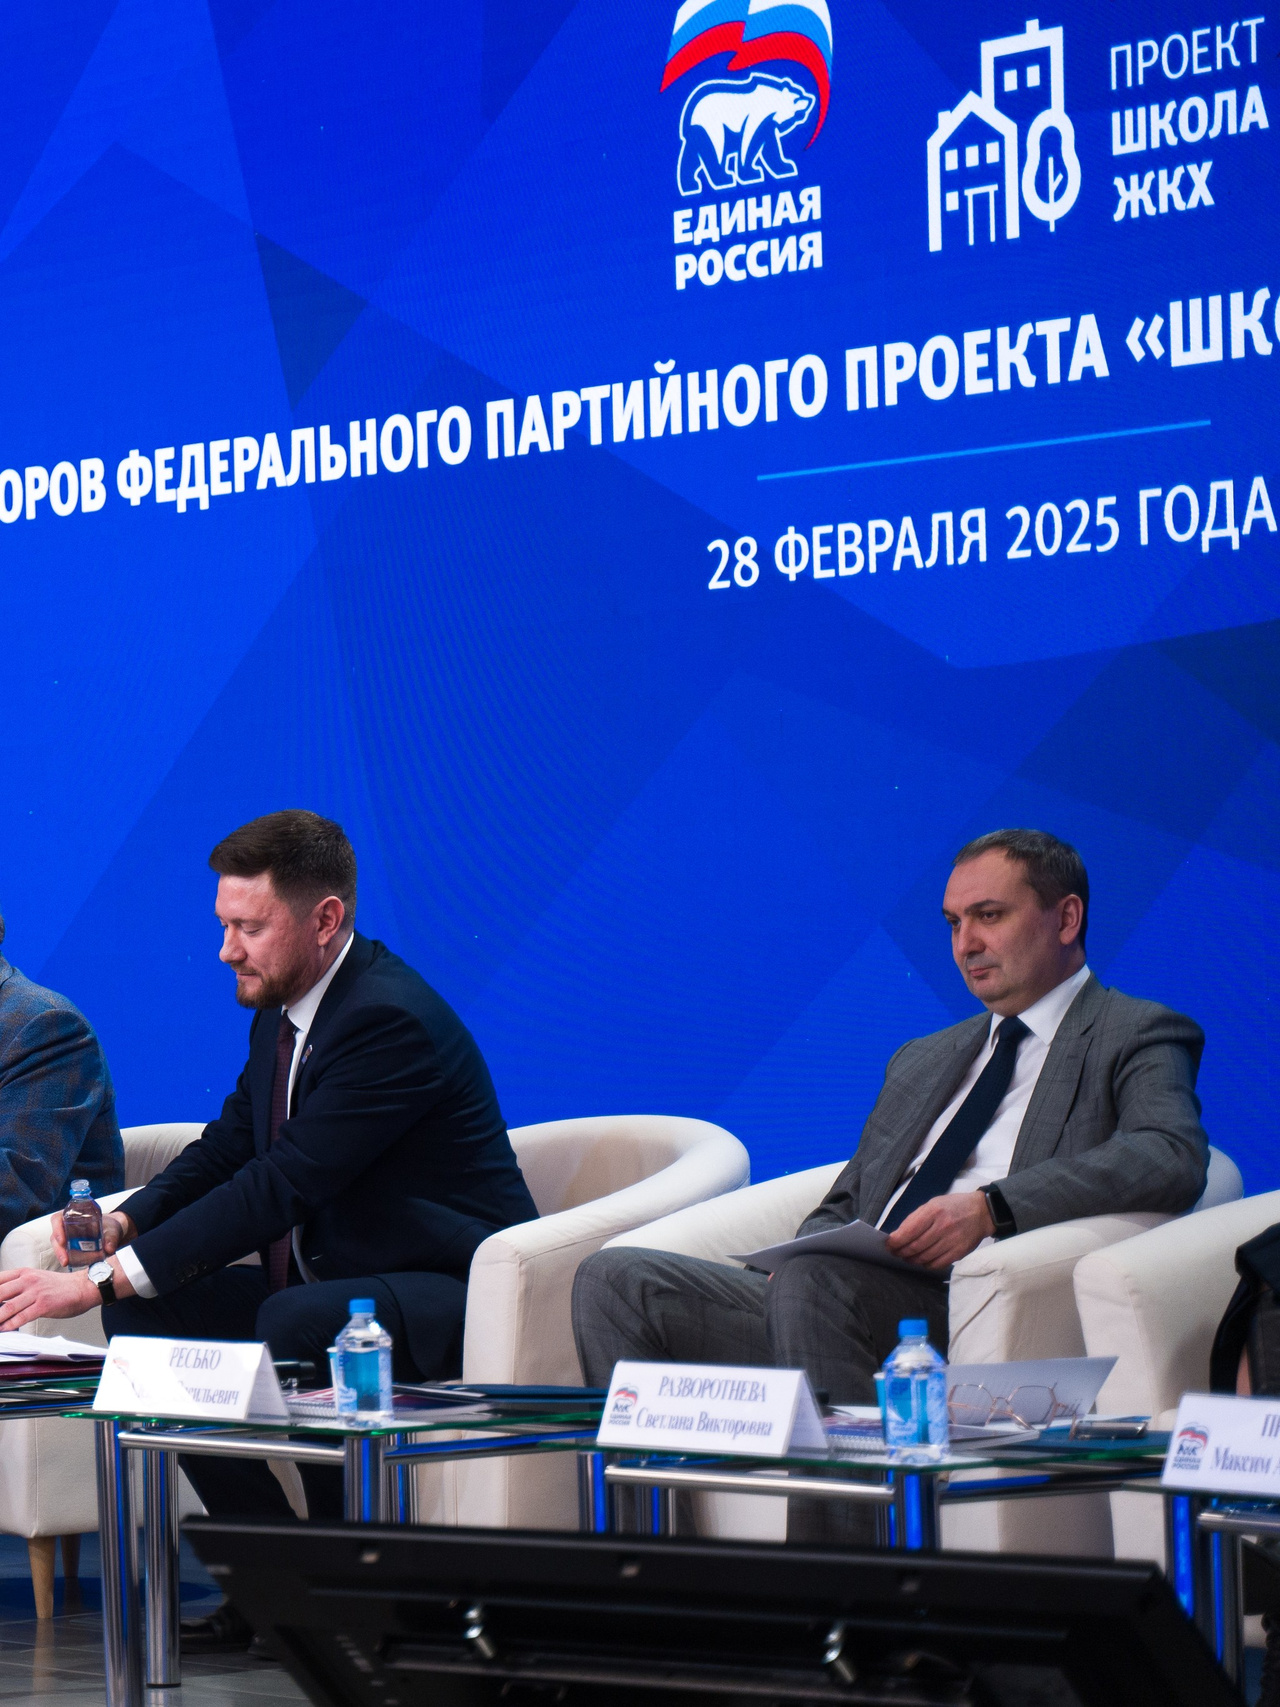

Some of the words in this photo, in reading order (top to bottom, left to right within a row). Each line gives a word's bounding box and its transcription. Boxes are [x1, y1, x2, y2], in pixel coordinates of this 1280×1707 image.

[1110, 17, 1266, 90] ПРОЕКТ
[1111, 85, 1270, 156] ШКОЛА
[672, 185, 822, 245] ЕДИНАЯ
[1113, 161, 1216, 223] ЖКХ
[675, 231, 823, 291] РОССИЯ
[115, 404, 473, 514] ФЕДЕРАЛЬНОГО
[485, 353, 829, 461] ПАРТИЙНОГО
[844, 312, 1111, 412] ПРОЕКТА
[1124, 285, 1280, 368] «ШК
[705, 535, 762, 591] 28
[772, 506, 989, 583] ФЕВРАЛЯ
[1005, 494, 1121, 561] 2025
[1138, 474, 1279, 554] ГОДА
[168, 1346, 222, 1371] РЕСЬКО
[657, 1375, 768, 1403] РАЗВОРОТНЕВА
[636, 1406, 695, 1432] Светлана
[695, 1410, 774, 1441] Викторовна
[1209, 1446, 1273, 1474] Максим
